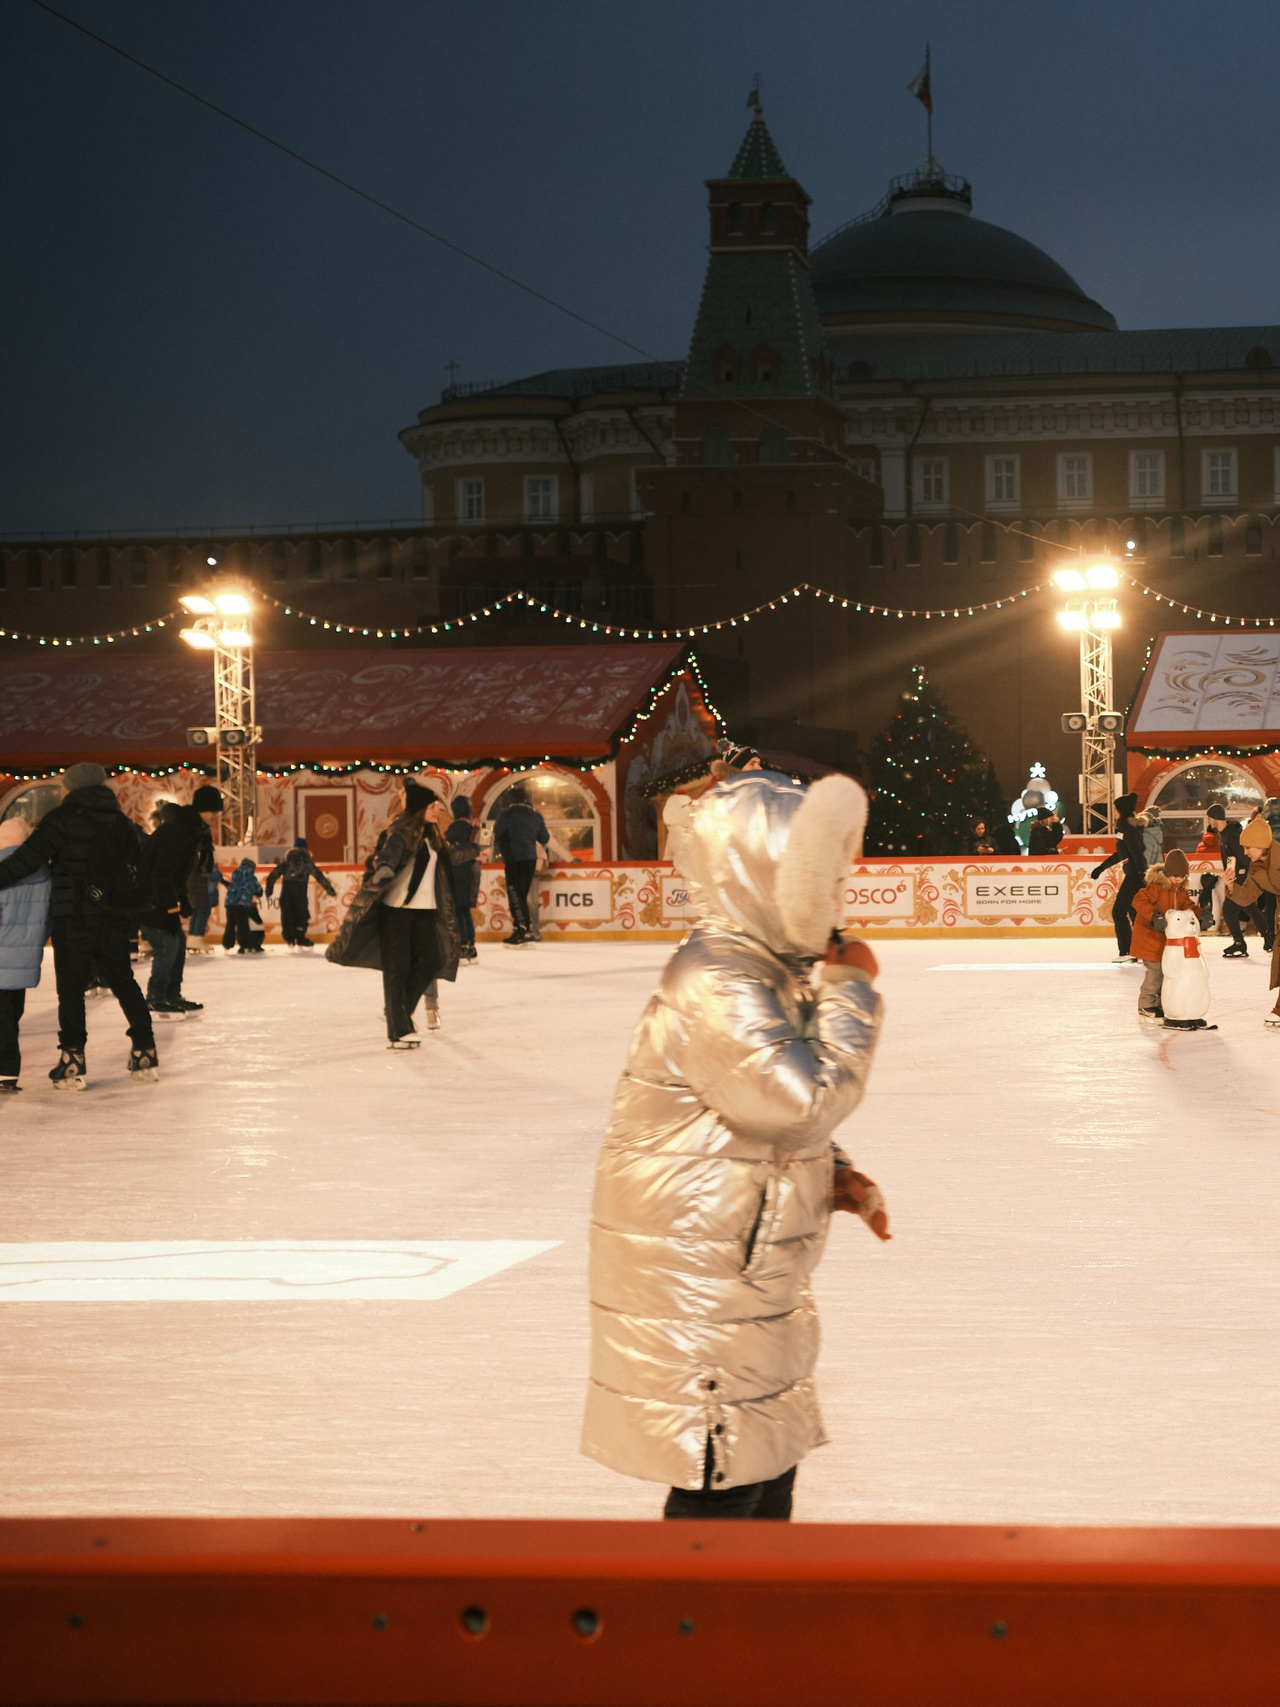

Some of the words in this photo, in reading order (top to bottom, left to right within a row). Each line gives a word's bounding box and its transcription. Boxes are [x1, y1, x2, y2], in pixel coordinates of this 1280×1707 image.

[845, 888, 897, 904] OSCO
[976, 885, 1059, 896] EXEED
[555, 893, 594, 907] ПСБ
